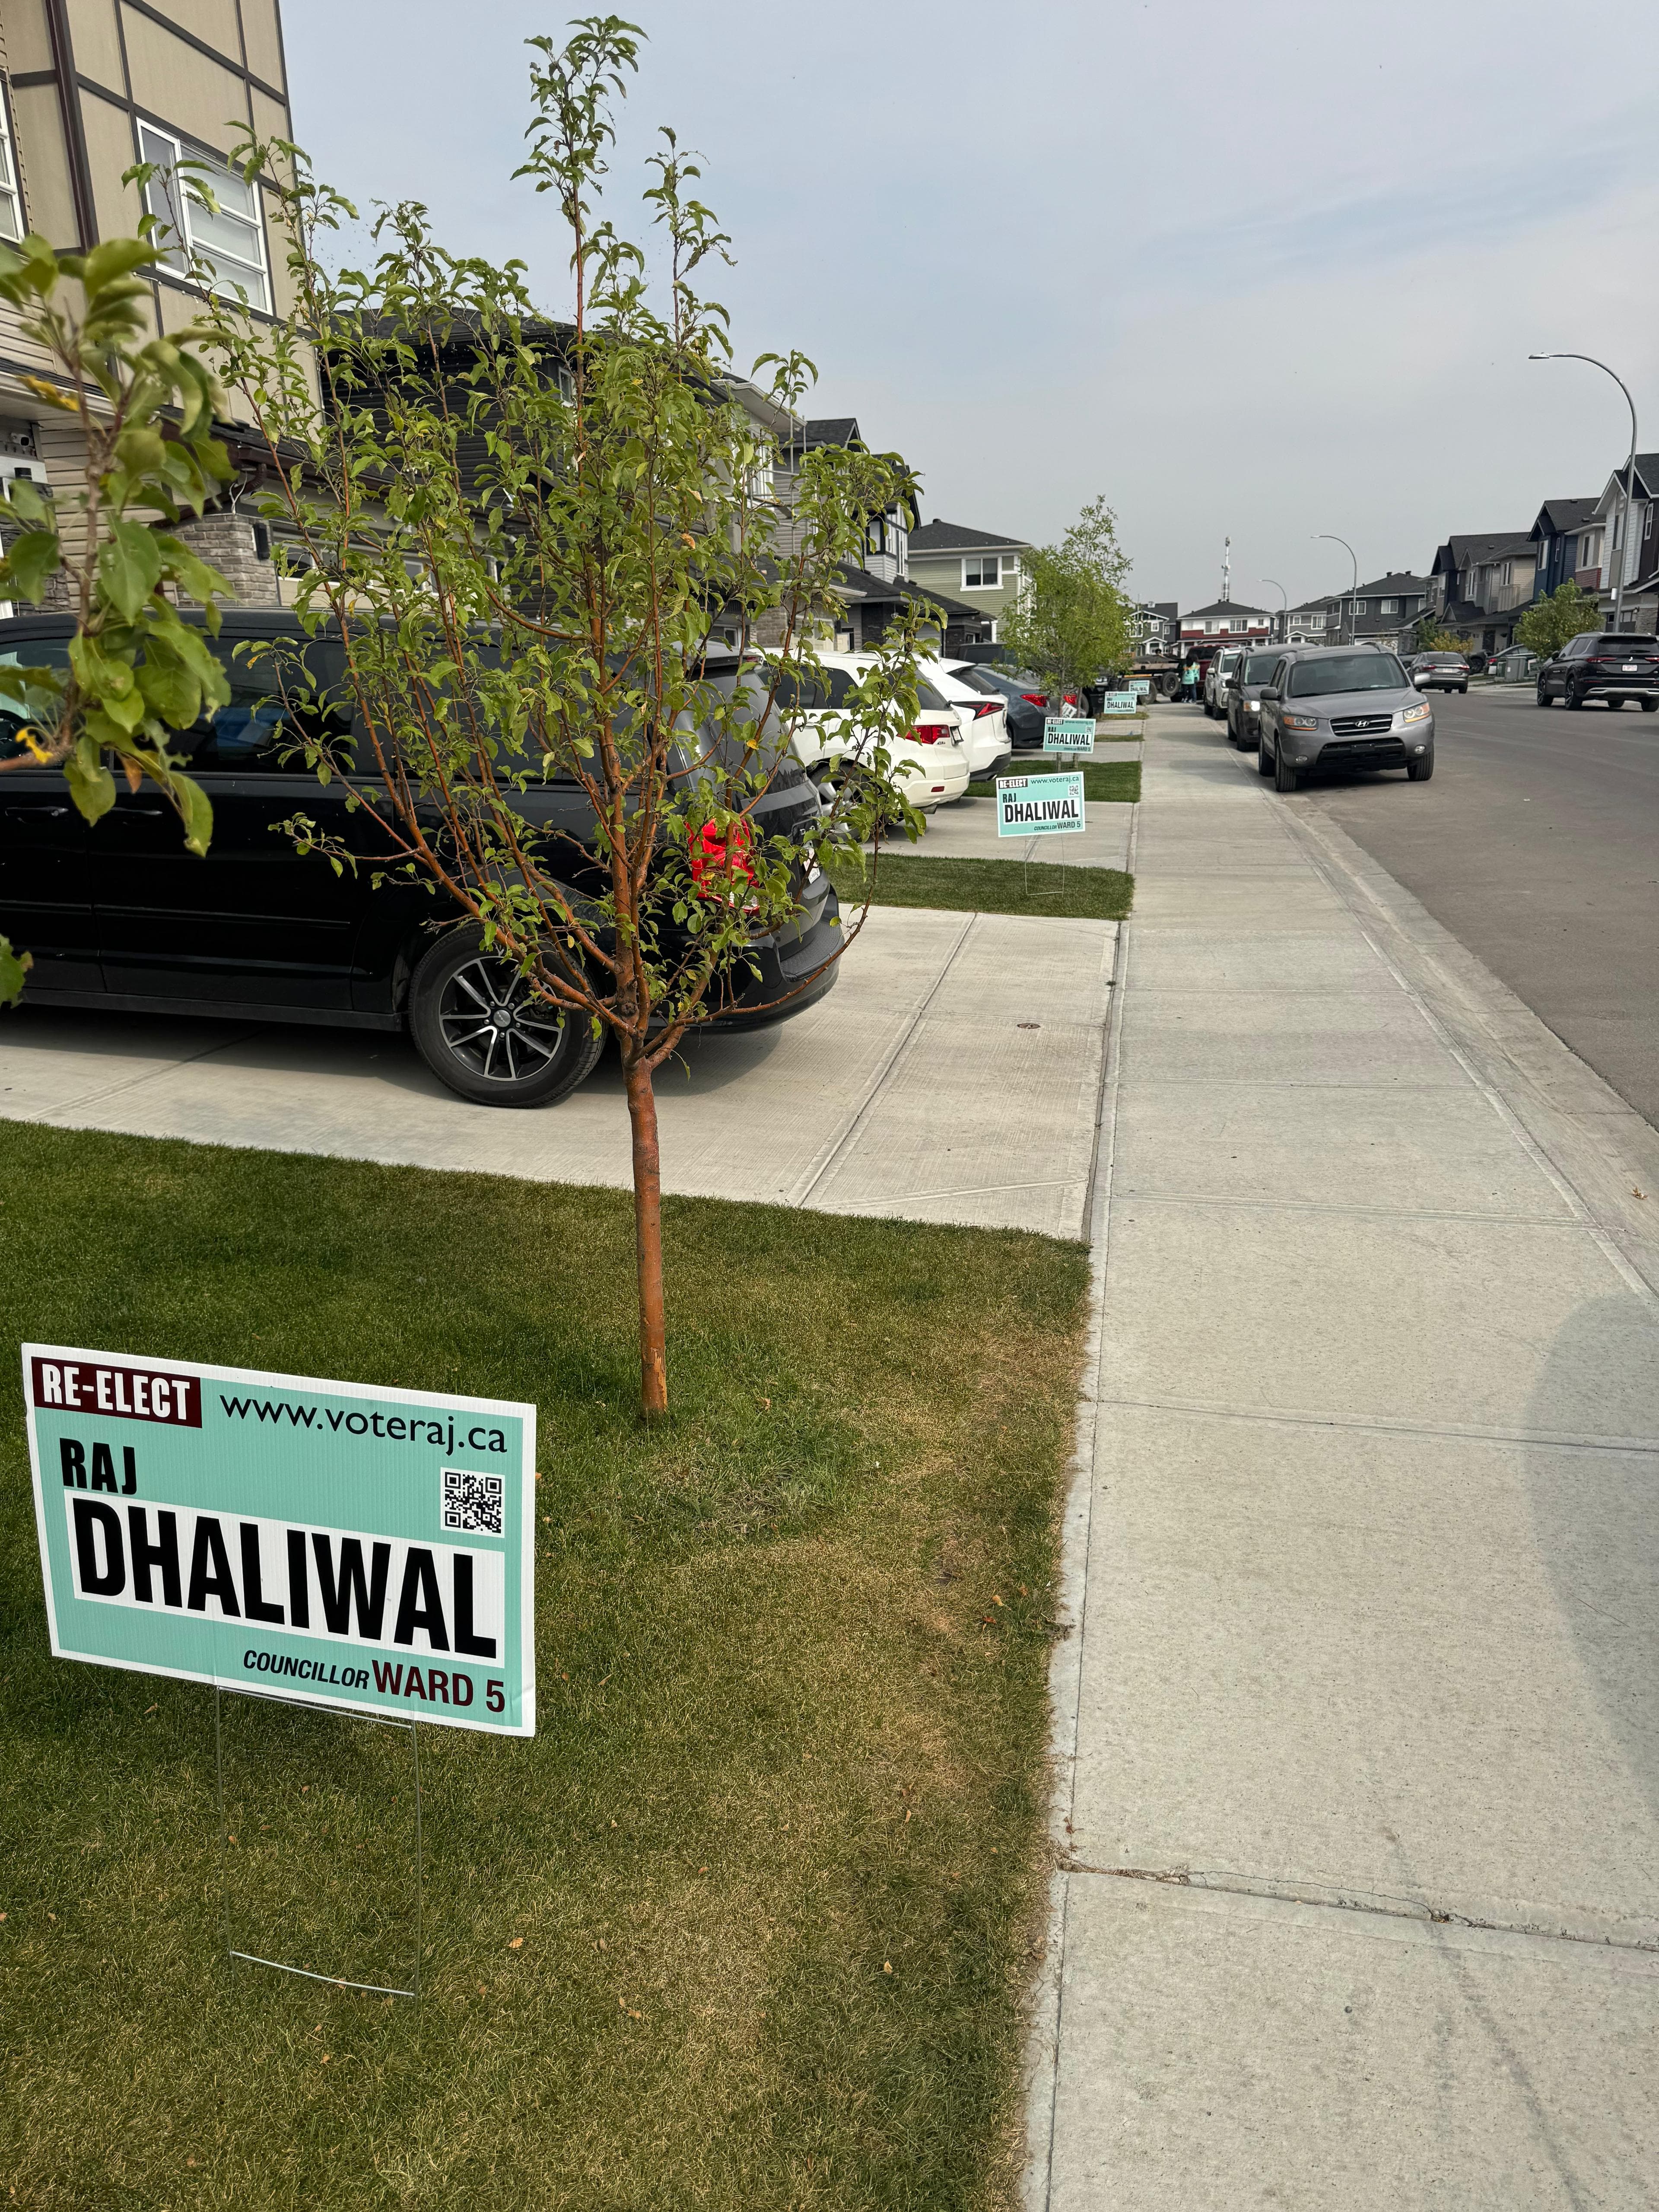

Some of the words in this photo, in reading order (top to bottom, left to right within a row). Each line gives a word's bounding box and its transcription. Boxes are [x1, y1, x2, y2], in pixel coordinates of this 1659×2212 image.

[1048, 733, 1090, 745] DHALIWAL
[999, 779, 1027, 789] RE-ELECT
[1031, 776, 1079, 784] www.voteraj.ca
[1003, 793, 1016, 803] RAJ
[1004, 800, 1079, 823] DHALIWAL
[42, 1363, 191, 1420] RE-ELECT
[219, 1395, 508, 1456] www.voteraj.ca
[59, 1437, 138, 1495] RAJ
[73, 1497, 497, 1659] DHALIWAL
[243, 1649, 368, 1690] COUNCILLOR
[371, 1659, 474, 1707] WARD
[485, 1681, 505, 1712] 5
